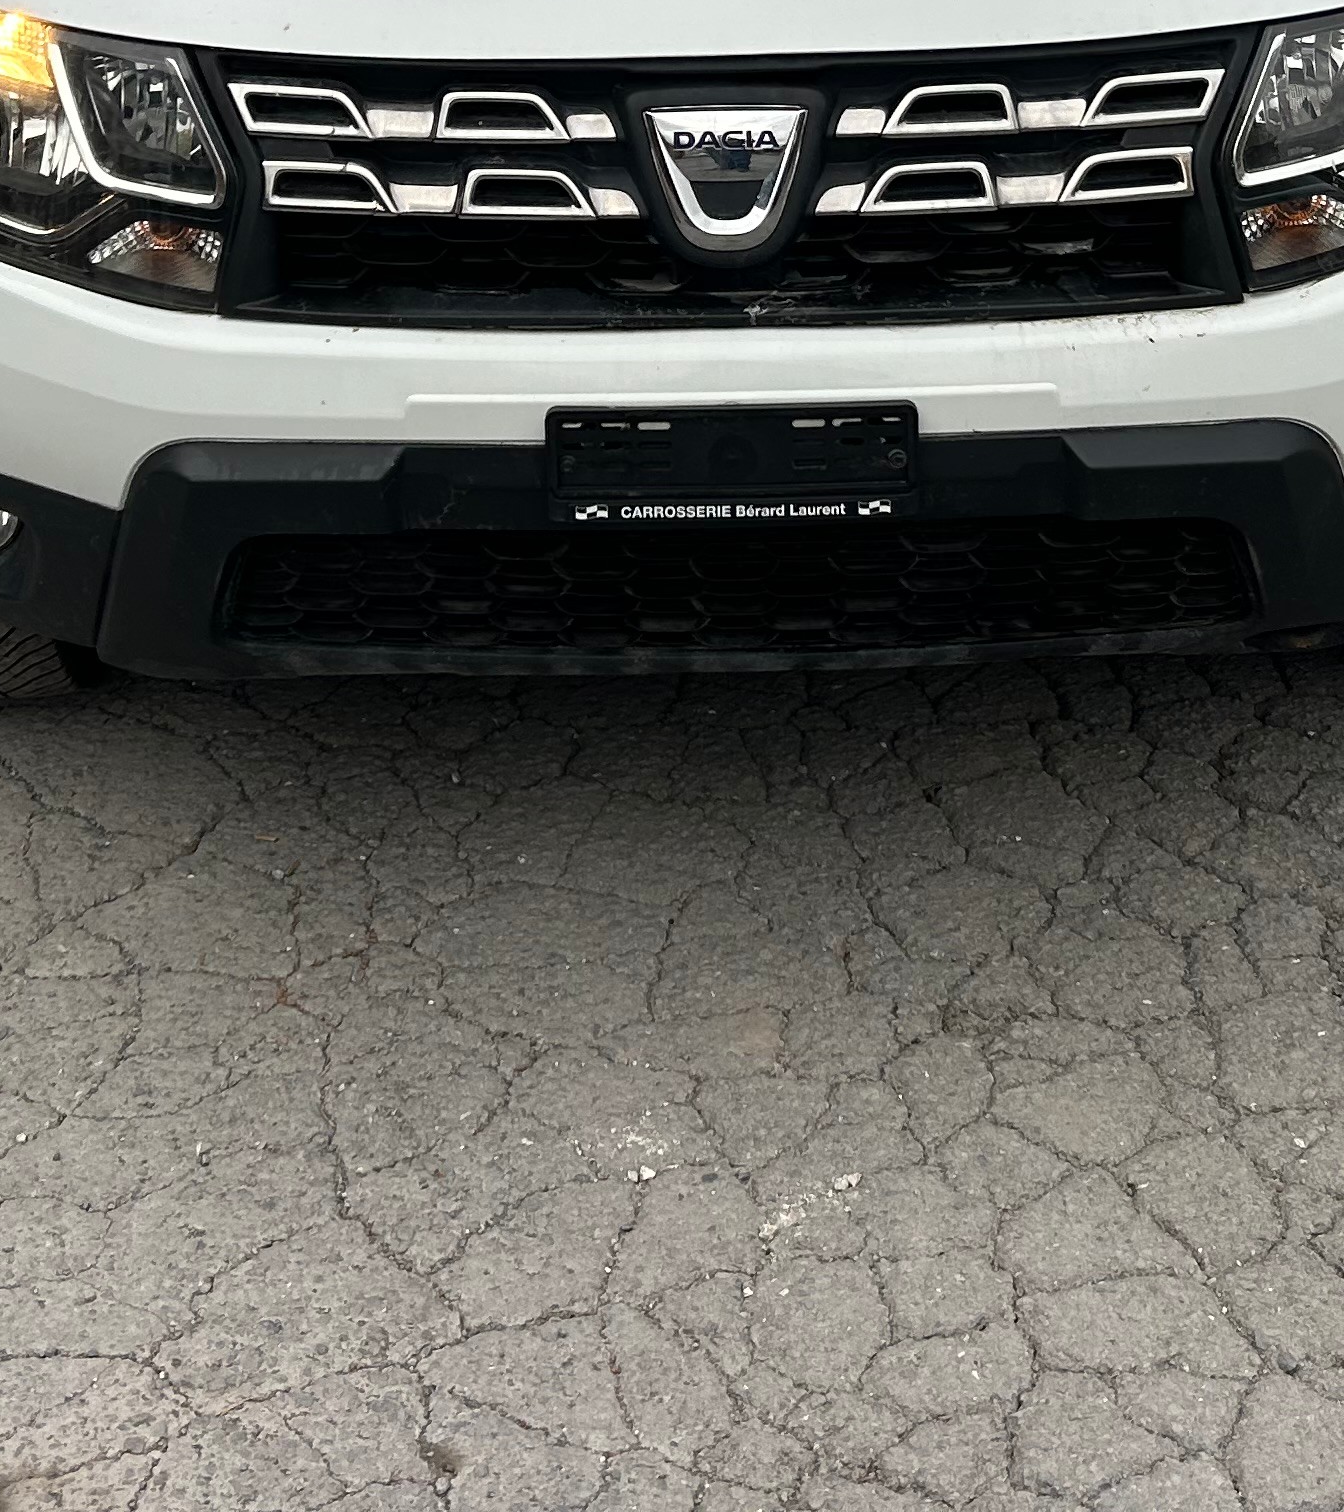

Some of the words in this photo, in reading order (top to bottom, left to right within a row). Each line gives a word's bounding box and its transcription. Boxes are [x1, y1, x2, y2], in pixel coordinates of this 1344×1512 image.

[673, 130, 780, 149] DACIA
[620, 505, 732, 519] CARROSSERIE
[735, 504, 785, 517] Bérard
[789, 503, 847, 516] Laurent
